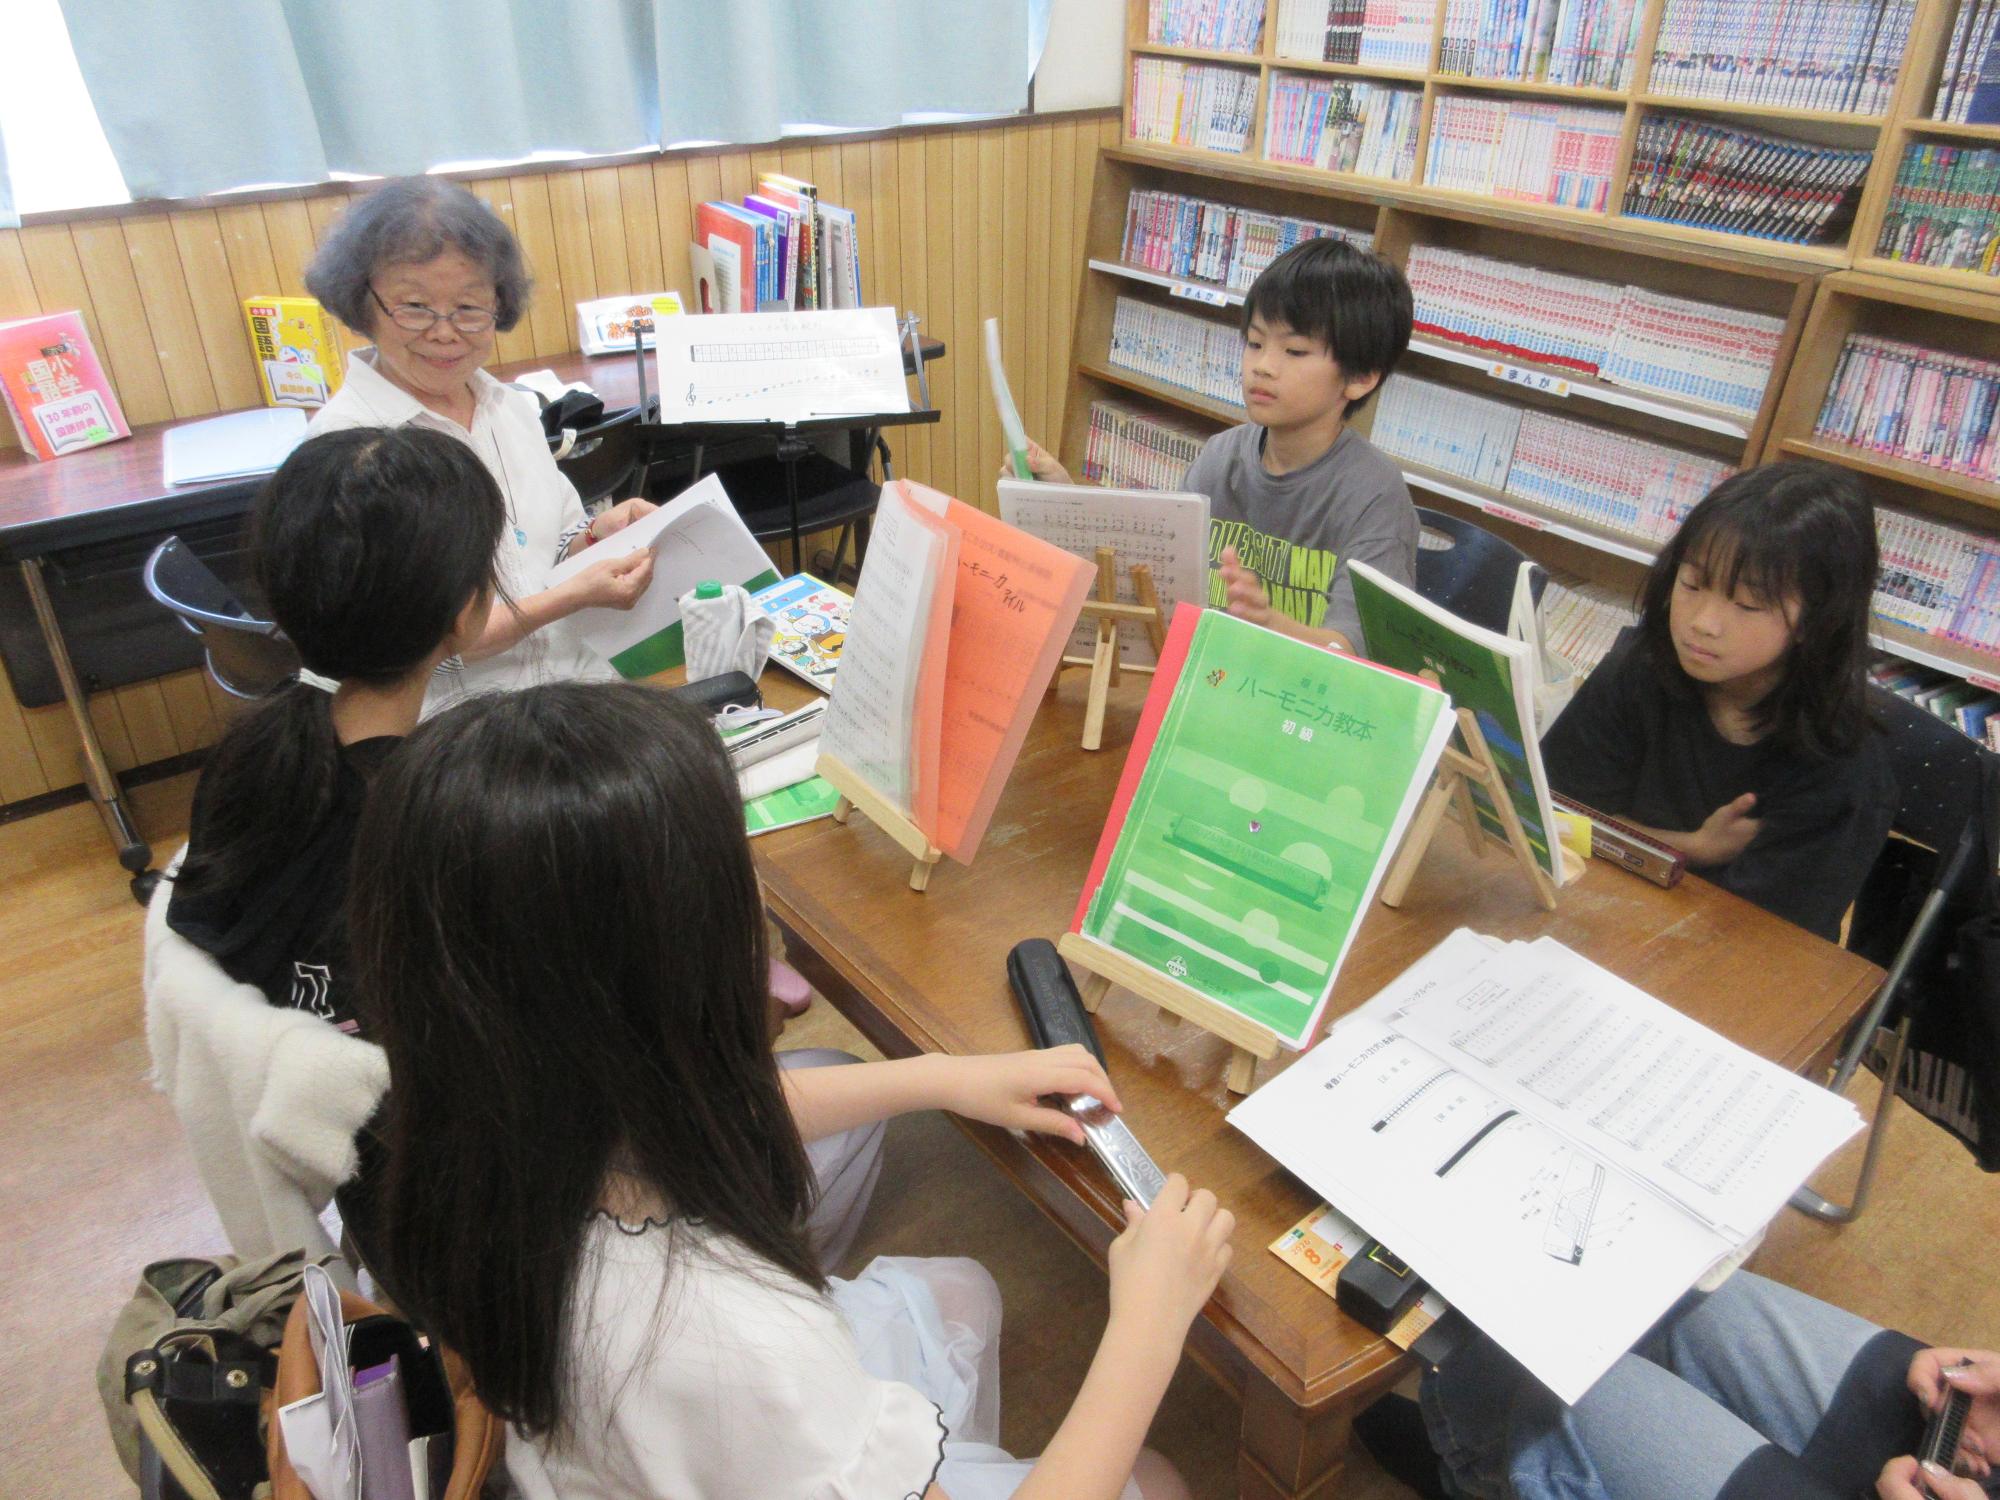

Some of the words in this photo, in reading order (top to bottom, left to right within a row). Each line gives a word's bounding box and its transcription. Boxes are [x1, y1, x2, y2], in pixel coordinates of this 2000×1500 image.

[1508, 369, 1551, 388] まんが
[1237, 675, 1377, 741] ハーモニカ教本
[1280, 719, 1314, 743] 初級
[1304, 1248, 1321, 1265] 8
